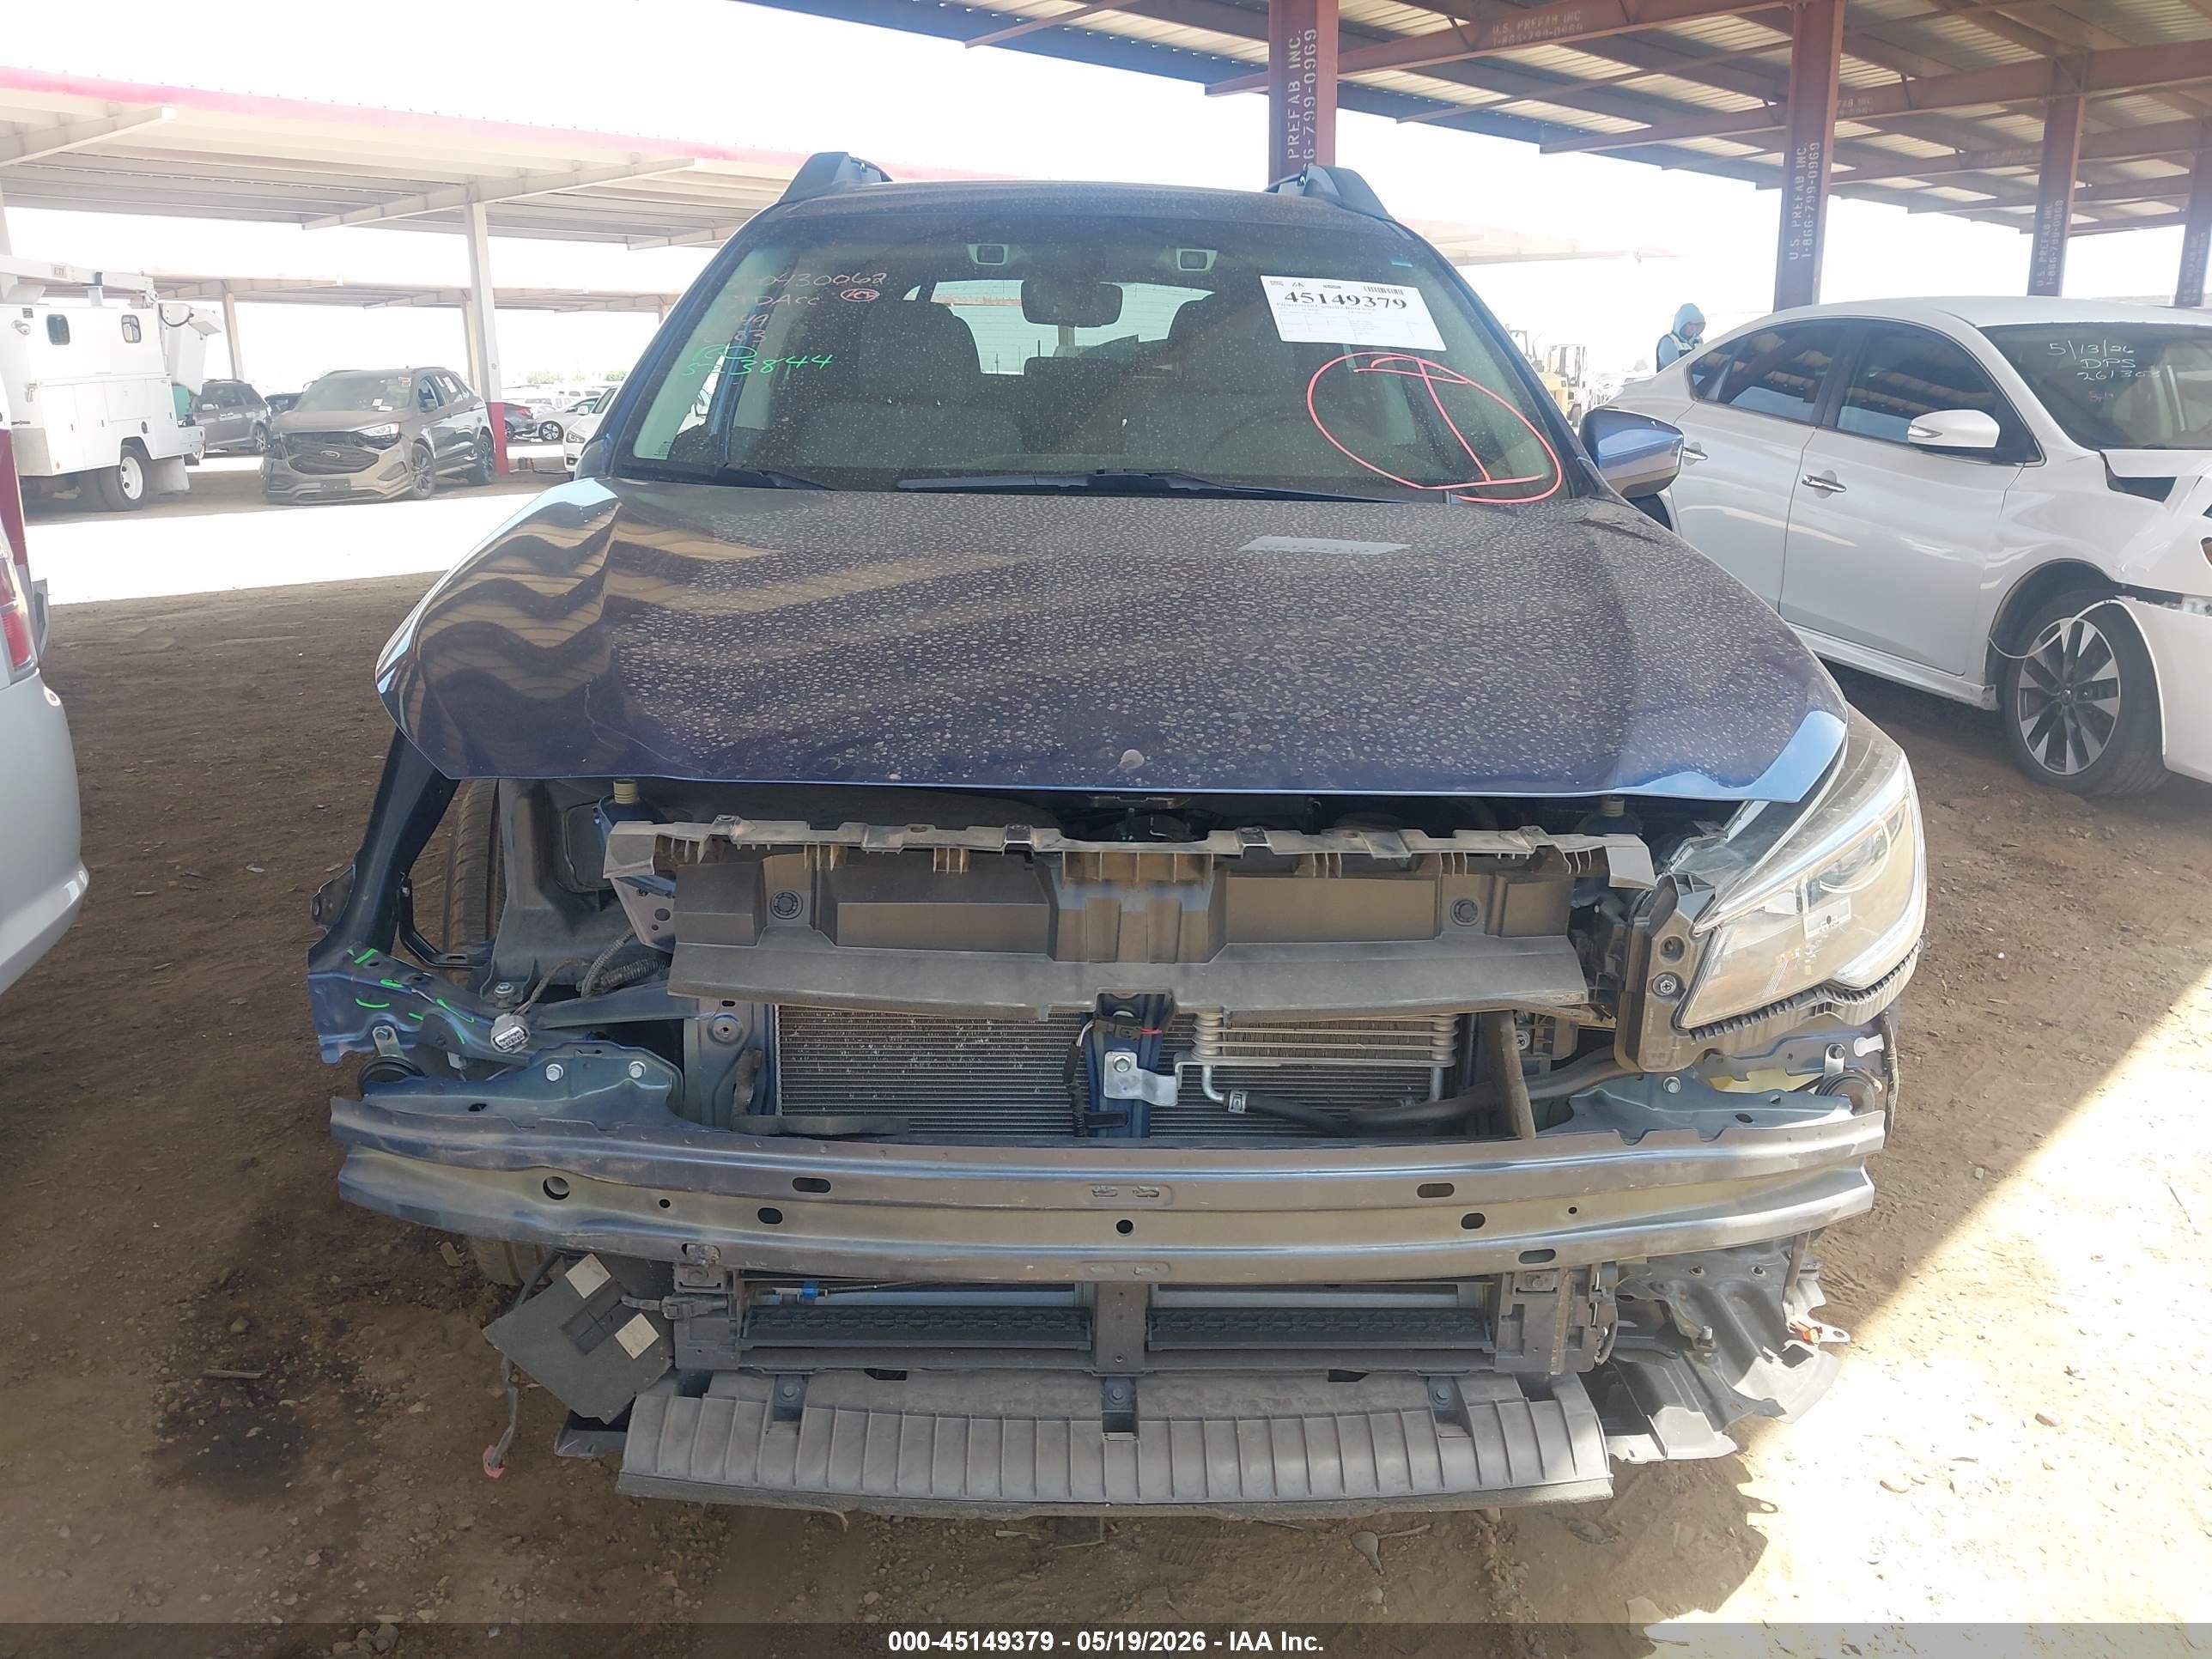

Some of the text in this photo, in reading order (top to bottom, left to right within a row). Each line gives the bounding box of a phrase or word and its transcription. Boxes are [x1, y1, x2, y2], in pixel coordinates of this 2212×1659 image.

[1287, 29, 1302, 159] PREFAB INC.
[1792, 176, 1804, 228] PREFAB
[1802, 142, 1820, 258] 1-866-799-0969
[1789, 236, 1801, 261] U.S.
[1285, 291, 1407, 310] 45149379
[2080, 357, 2136, 369] DPS
